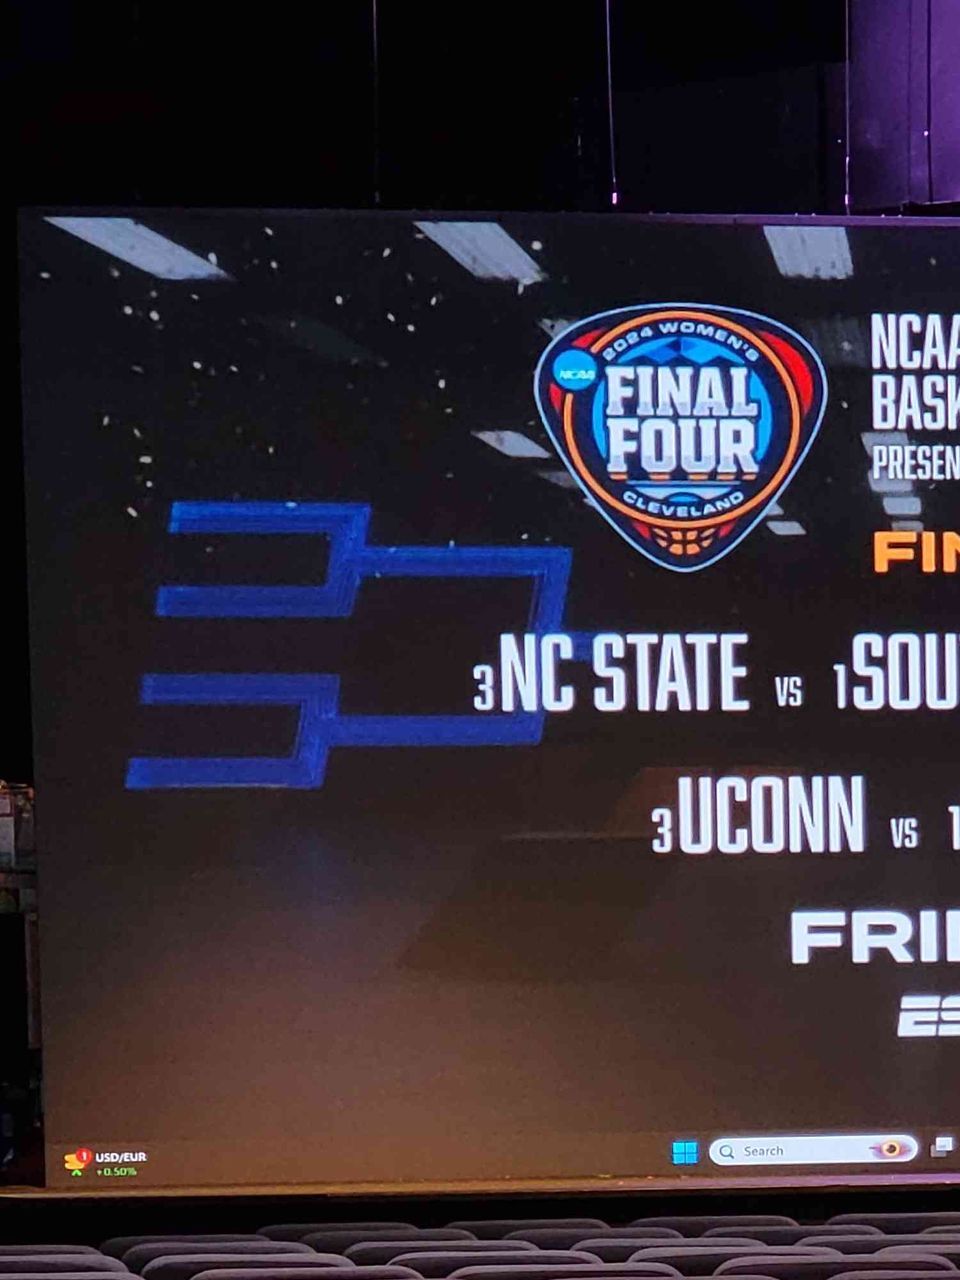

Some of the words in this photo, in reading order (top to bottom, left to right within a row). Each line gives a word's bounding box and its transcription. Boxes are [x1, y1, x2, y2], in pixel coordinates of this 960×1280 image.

[602, 326, 654, 362] 2024
[659, 322, 760, 362] WOMEN'S
[605, 366, 759, 416] FINAL
[606, 418, 760, 473] FOUR
[622, 491, 745, 518] CLEVELAND
[593, 634, 750, 711] STATE
[774, 675, 803, 707] VS
[889, 817, 919, 849] VS
[95, 1151, 147, 1163] USD/EUR
[744, 1145, 784, 1157] Search
